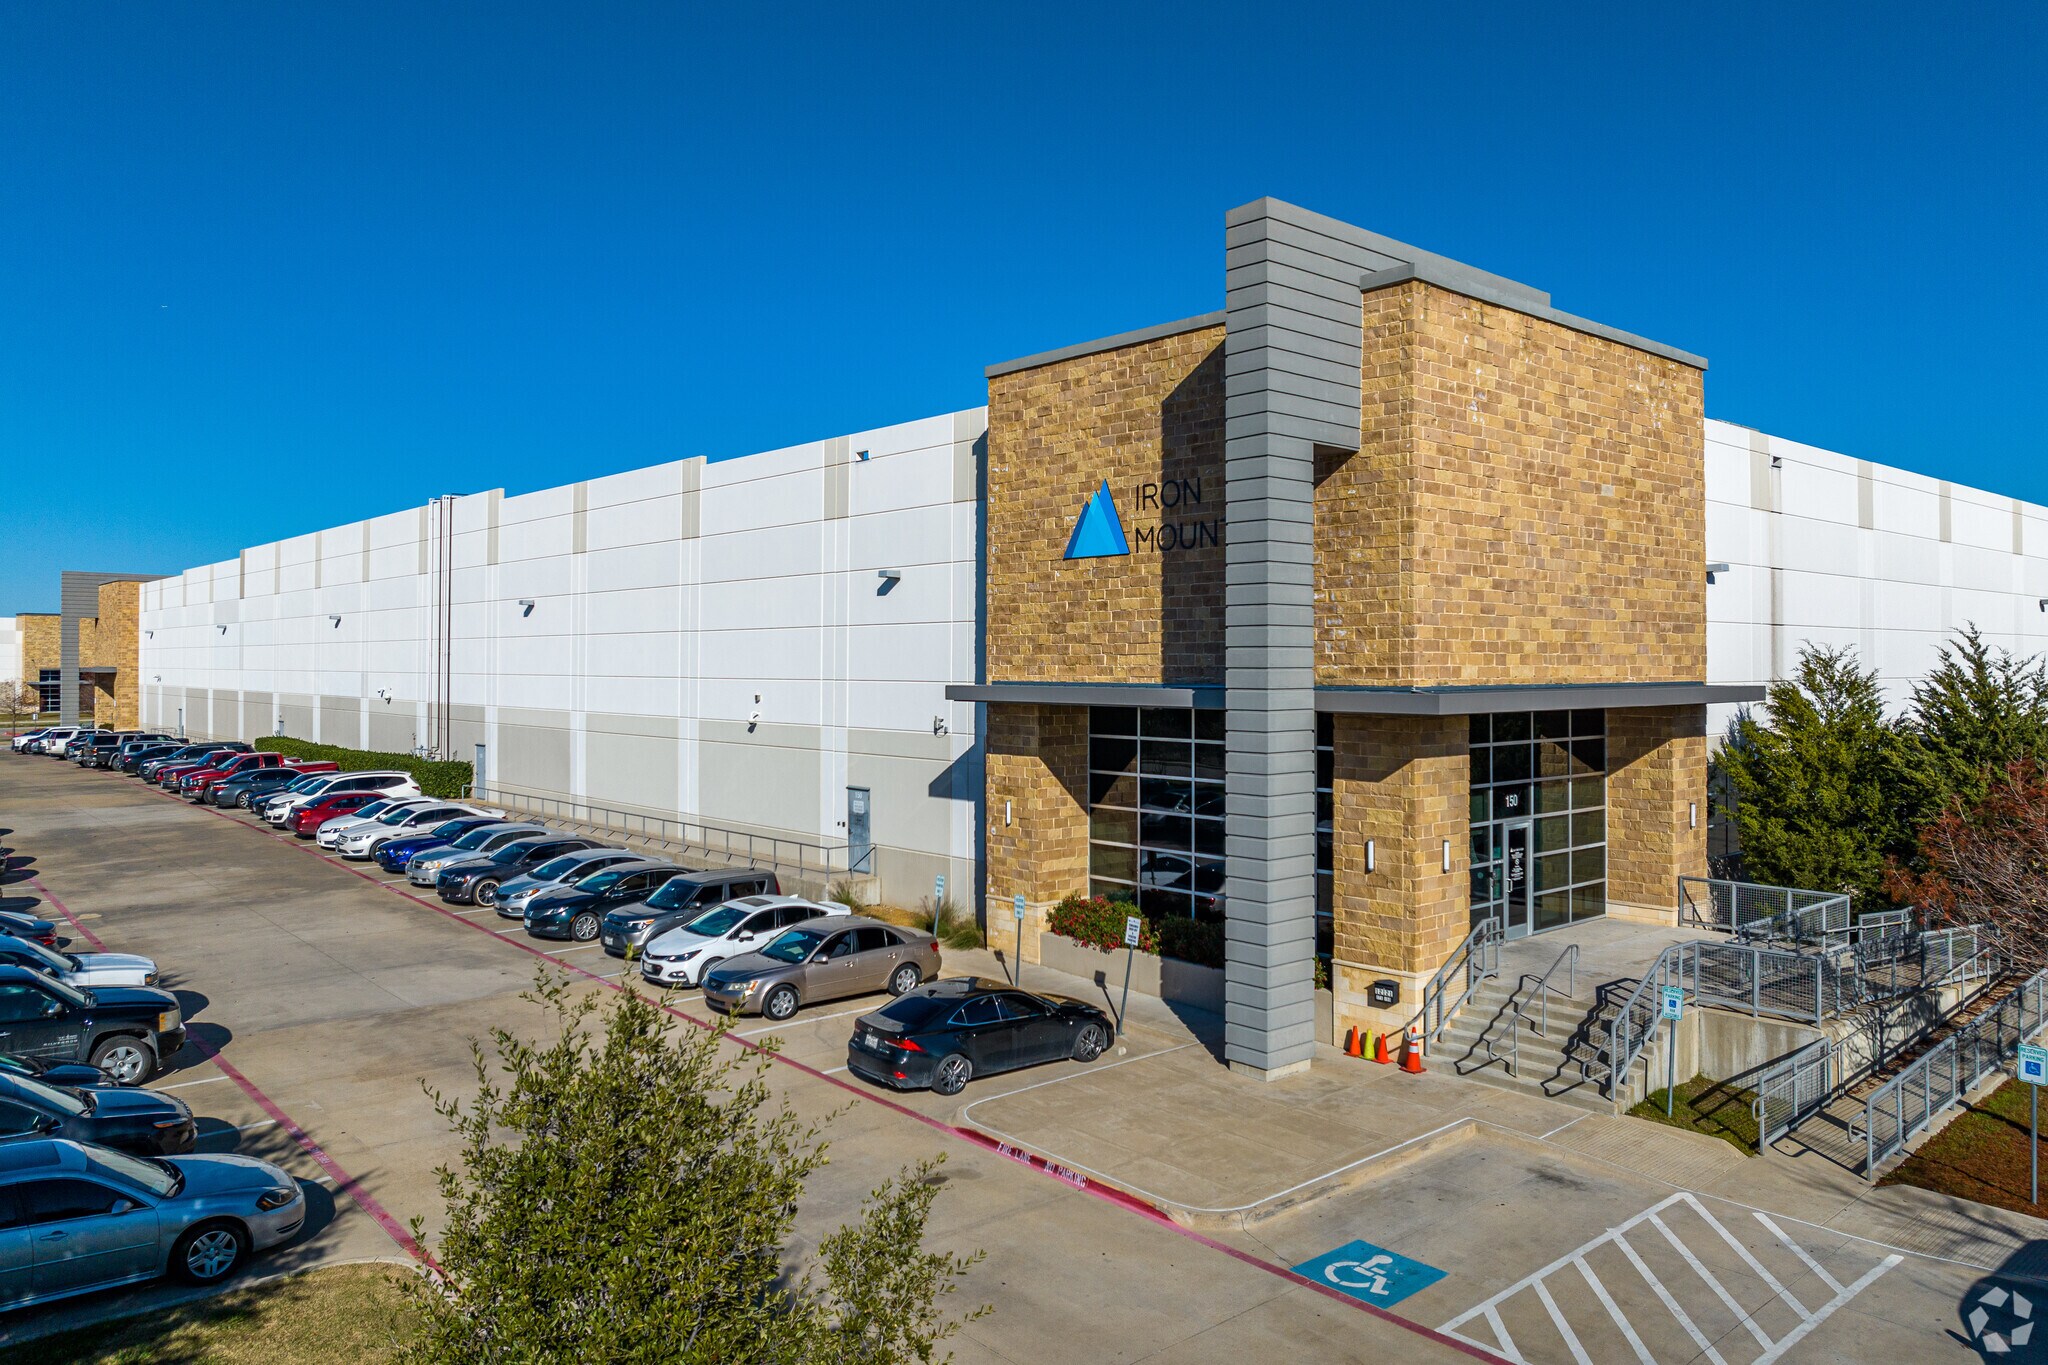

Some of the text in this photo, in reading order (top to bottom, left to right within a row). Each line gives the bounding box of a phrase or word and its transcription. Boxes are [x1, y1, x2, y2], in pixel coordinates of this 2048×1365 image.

[1135, 477, 1201, 511] IRON
[1135, 518, 1226, 554] MOUN
[1505, 794, 1518, 807] 150
[2020, 1046, 2046, 1056] RESERVED
[2021, 1053, 2045, 1063] PARKING
[996, 1141, 1087, 1188] FIRE LANE NO PARKING
